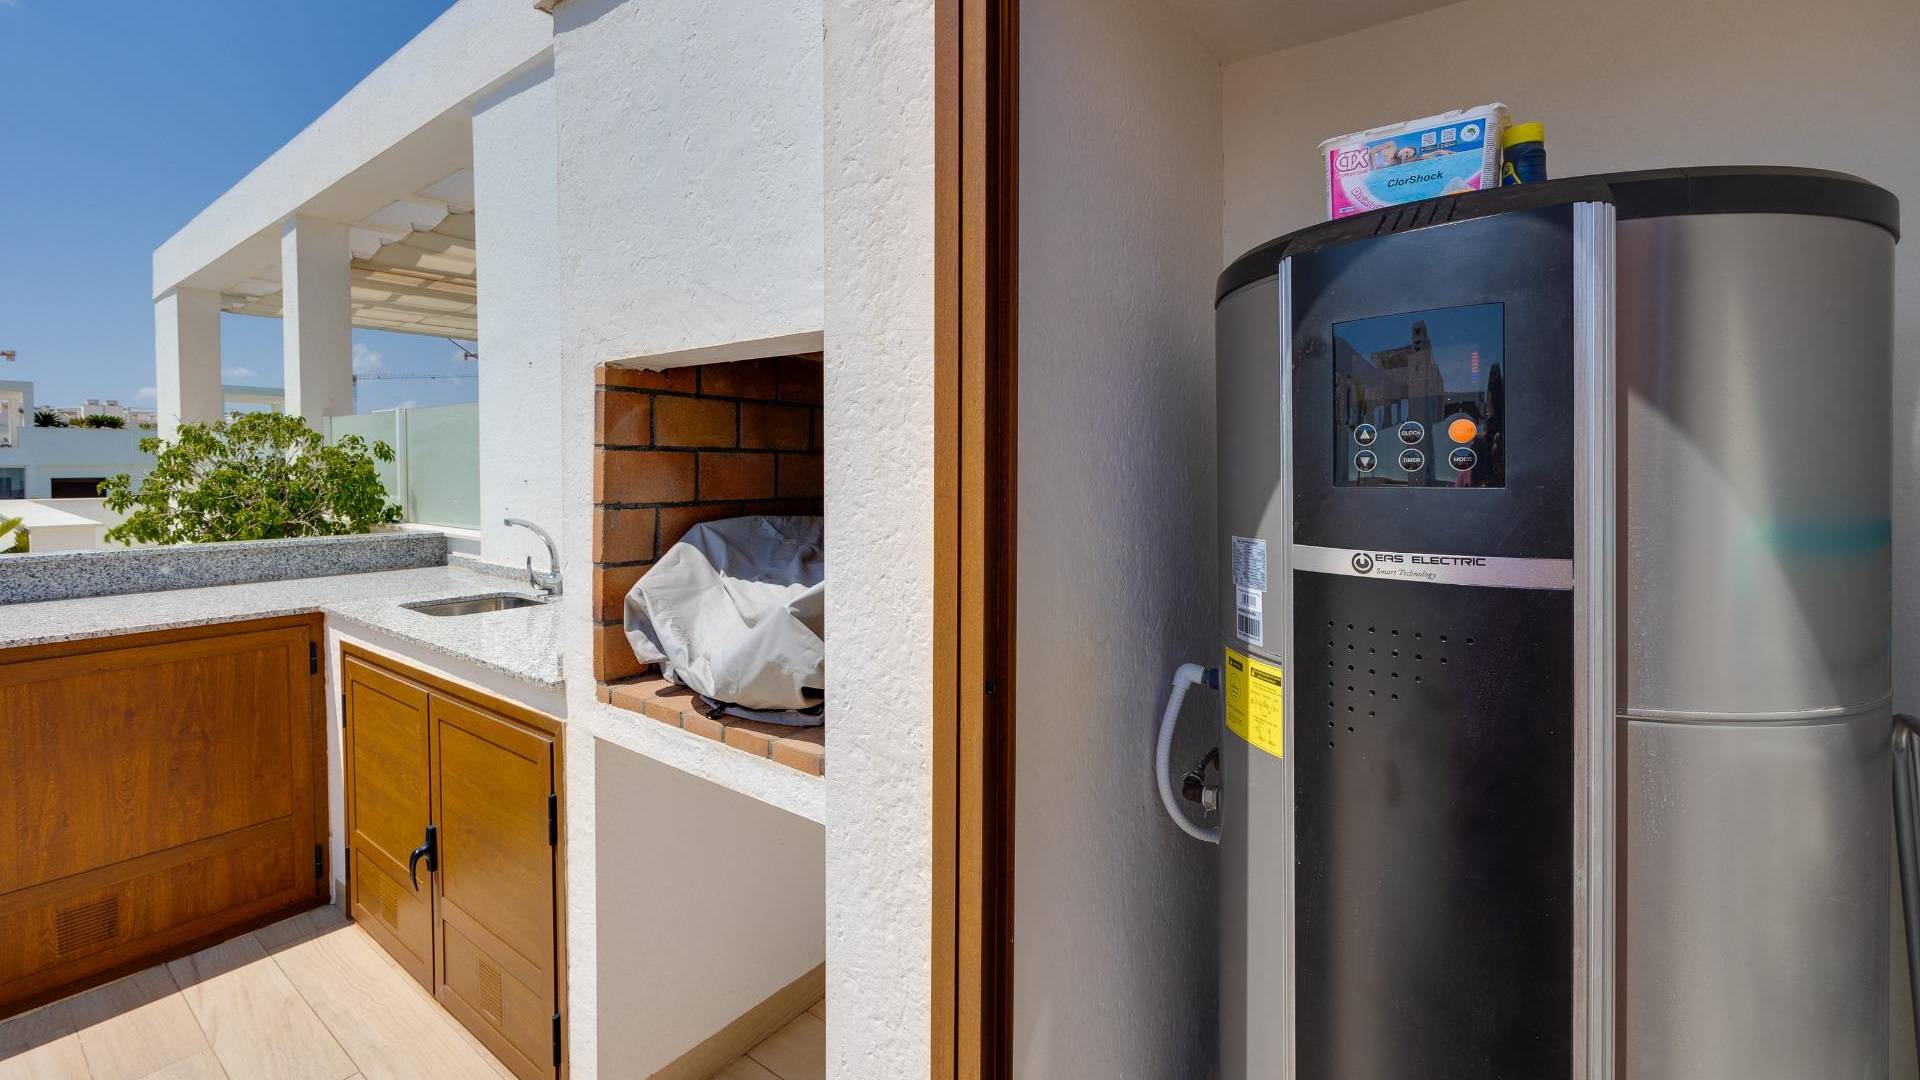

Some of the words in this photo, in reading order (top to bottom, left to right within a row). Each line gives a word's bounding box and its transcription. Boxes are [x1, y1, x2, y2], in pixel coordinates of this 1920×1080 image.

[1335, 148, 1369, 172] CTX
[1387, 170, 1444, 189] ClorShock
[1375, 554, 1404, 563] EAS
[1412, 555, 1487, 567] ELECTRIC
[1376, 567, 1397, 576] Smart
[1398, 569, 1437, 580] Technology
